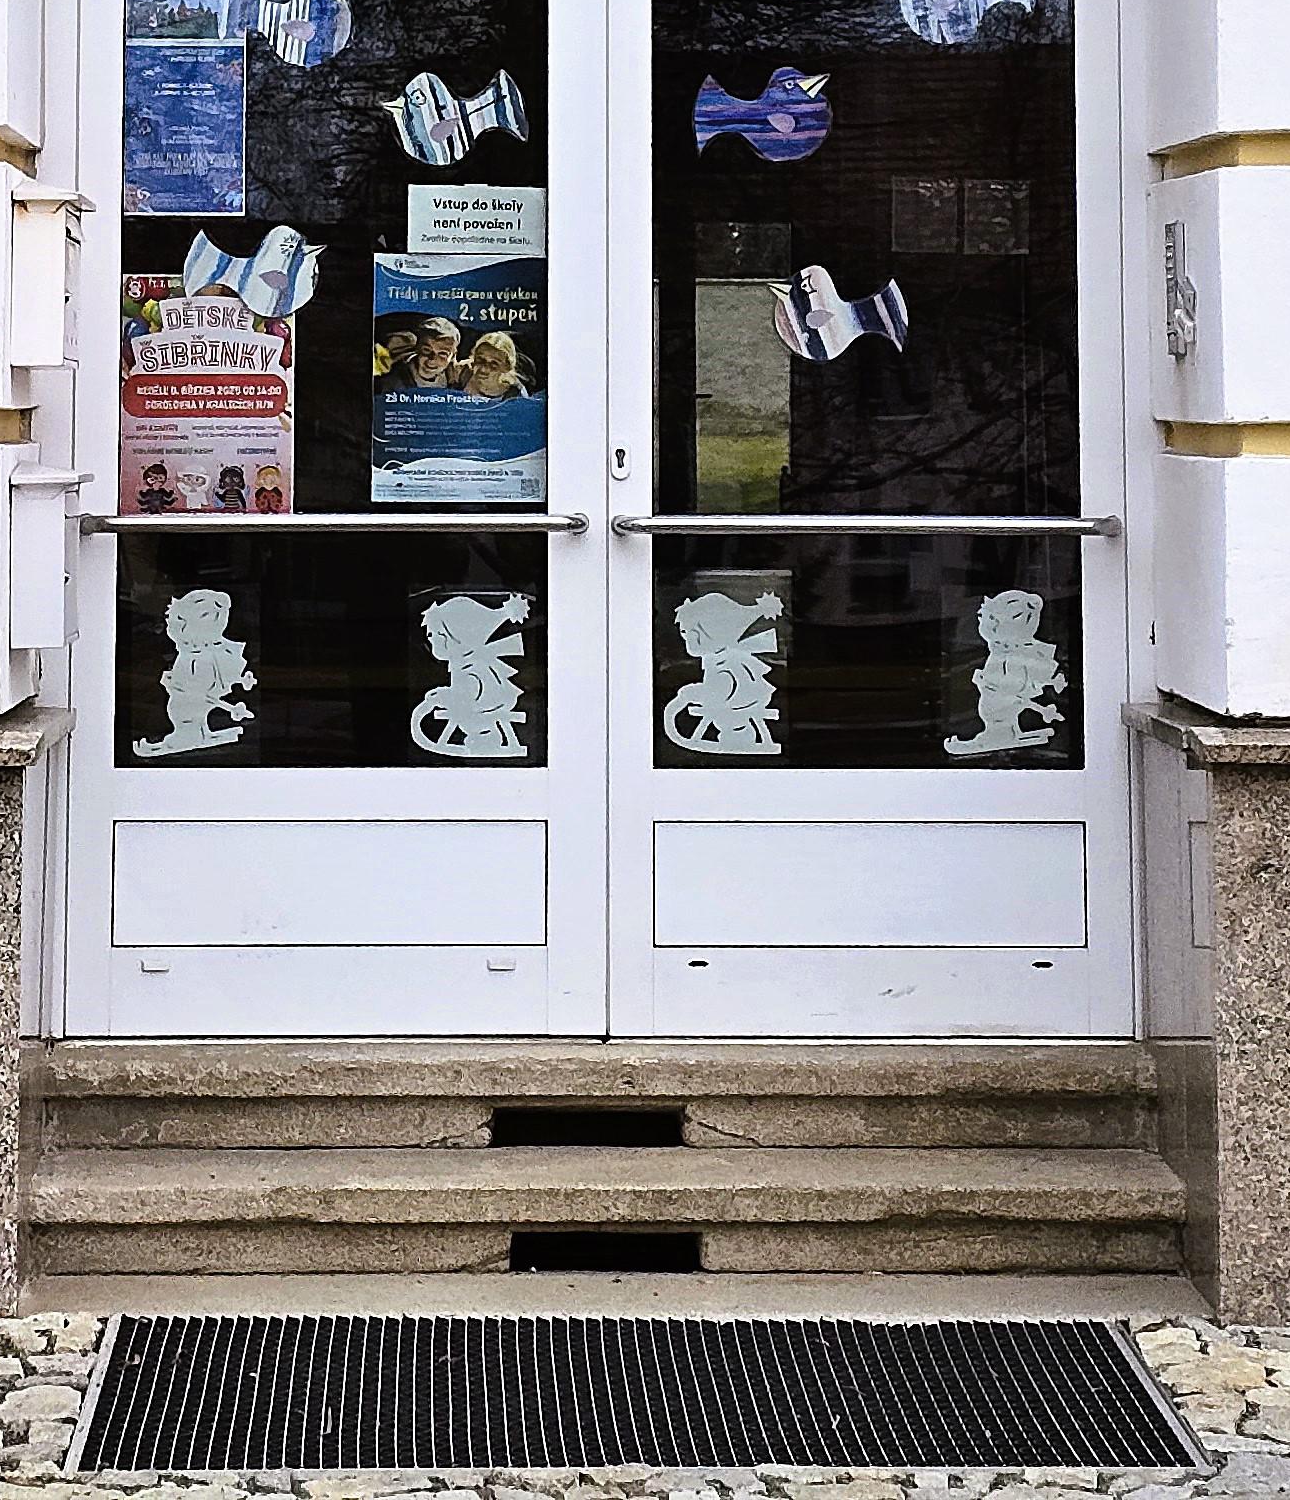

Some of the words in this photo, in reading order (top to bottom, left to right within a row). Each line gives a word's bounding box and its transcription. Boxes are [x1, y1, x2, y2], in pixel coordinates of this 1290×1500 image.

[433, 198, 468, 212] Vstup
[472, 198, 488, 211] do
[491, 198, 524, 213] školy
[433, 217, 460, 229] není
[463, 218, 513, 231] povolen
[496, 287, 538, 302] výukou
[459, 303, 474, 321] 2.
[479, 304, 537, 326] stupeň
[139, 334, 277, 372] ŠIBŘINKY
